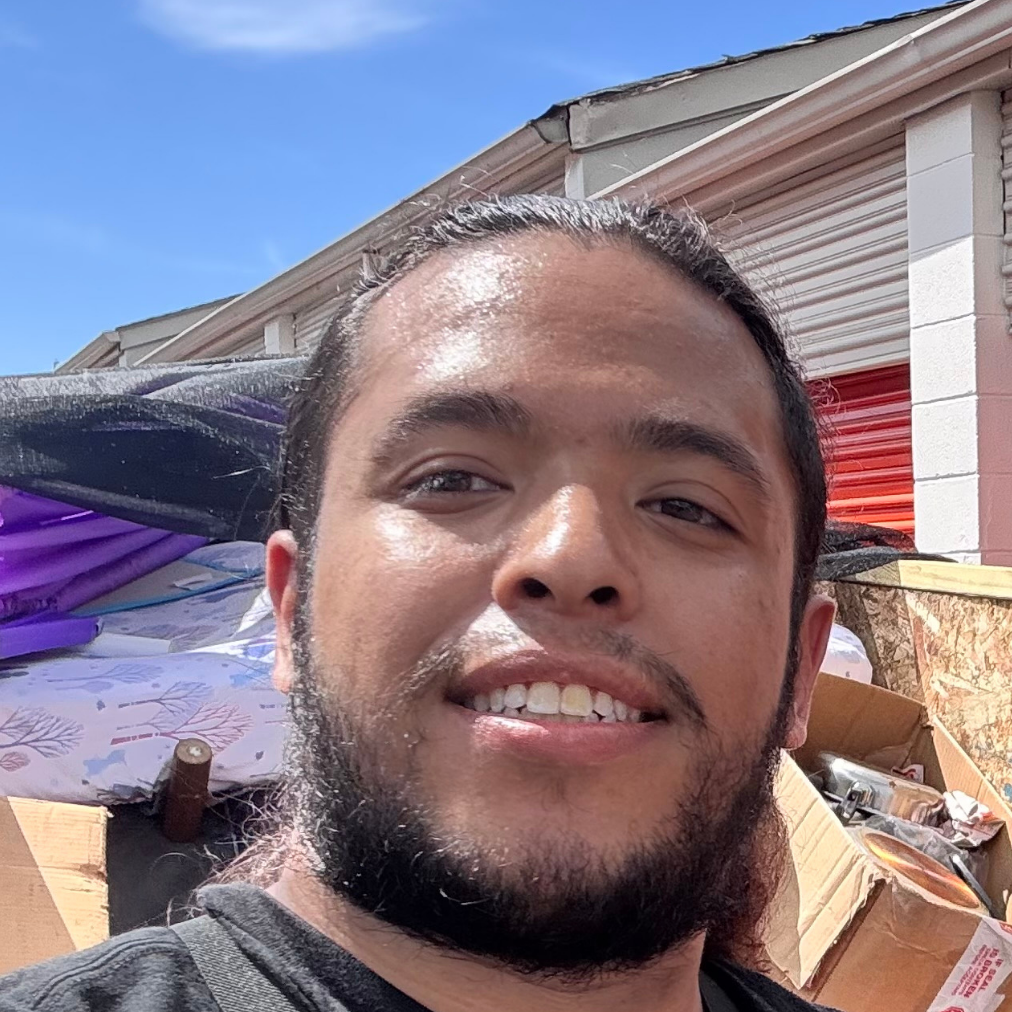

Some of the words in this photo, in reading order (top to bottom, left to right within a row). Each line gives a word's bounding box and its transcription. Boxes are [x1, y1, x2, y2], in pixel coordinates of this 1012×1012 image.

[994, 958, 1004, 967] IF
[963, 958, 992, 998] BROKEN
[977, 967, 997, 992] SEAL
